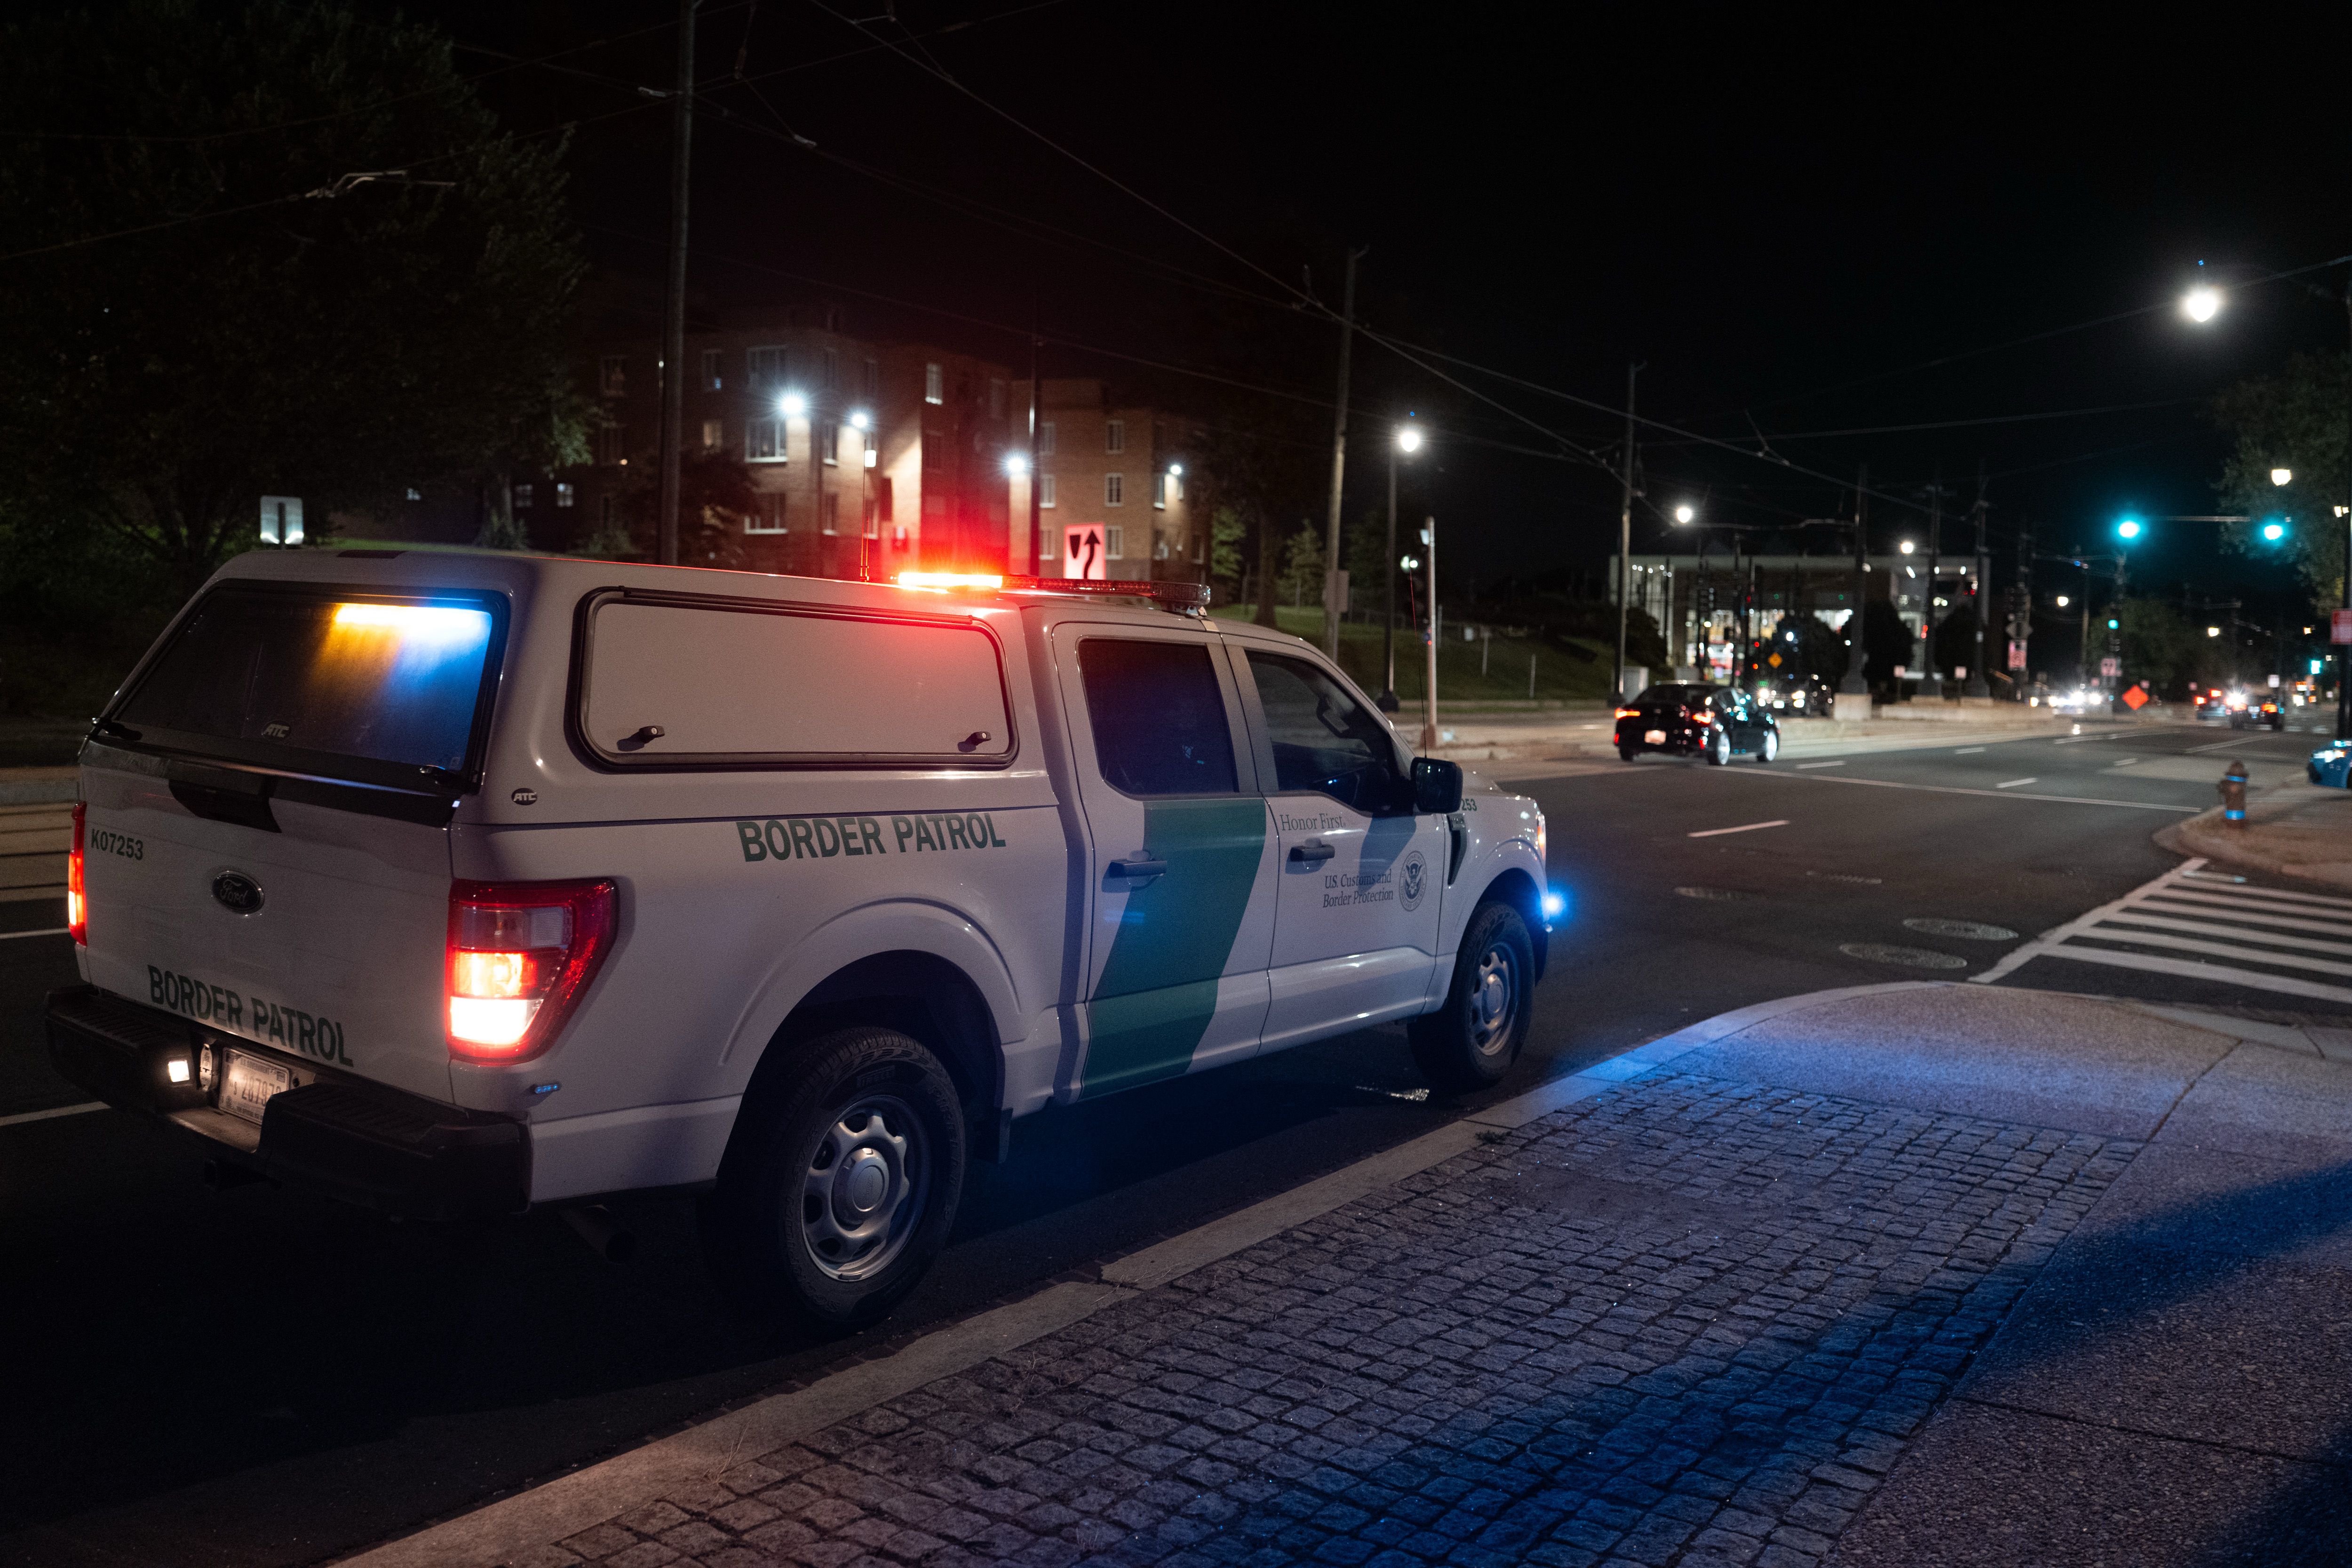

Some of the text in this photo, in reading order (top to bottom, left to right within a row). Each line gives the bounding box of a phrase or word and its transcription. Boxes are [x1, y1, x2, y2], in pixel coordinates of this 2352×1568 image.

[262, 724, 289, 738] ATC
[513, 792, 537, 801] ATC
[1279, 813, 1343, 831] Honor First
[91, 828, 143, 860] K07253
[736, 812, 1006, 862] BORDER PATROL
[1325, 868, 1391, 888] U.S. Customs and
[219, 879, 248, 905] Ford
[1323, 888, 1393, 907] Border Protection
[148, 964, 354, 1067] BORDER PATROL
